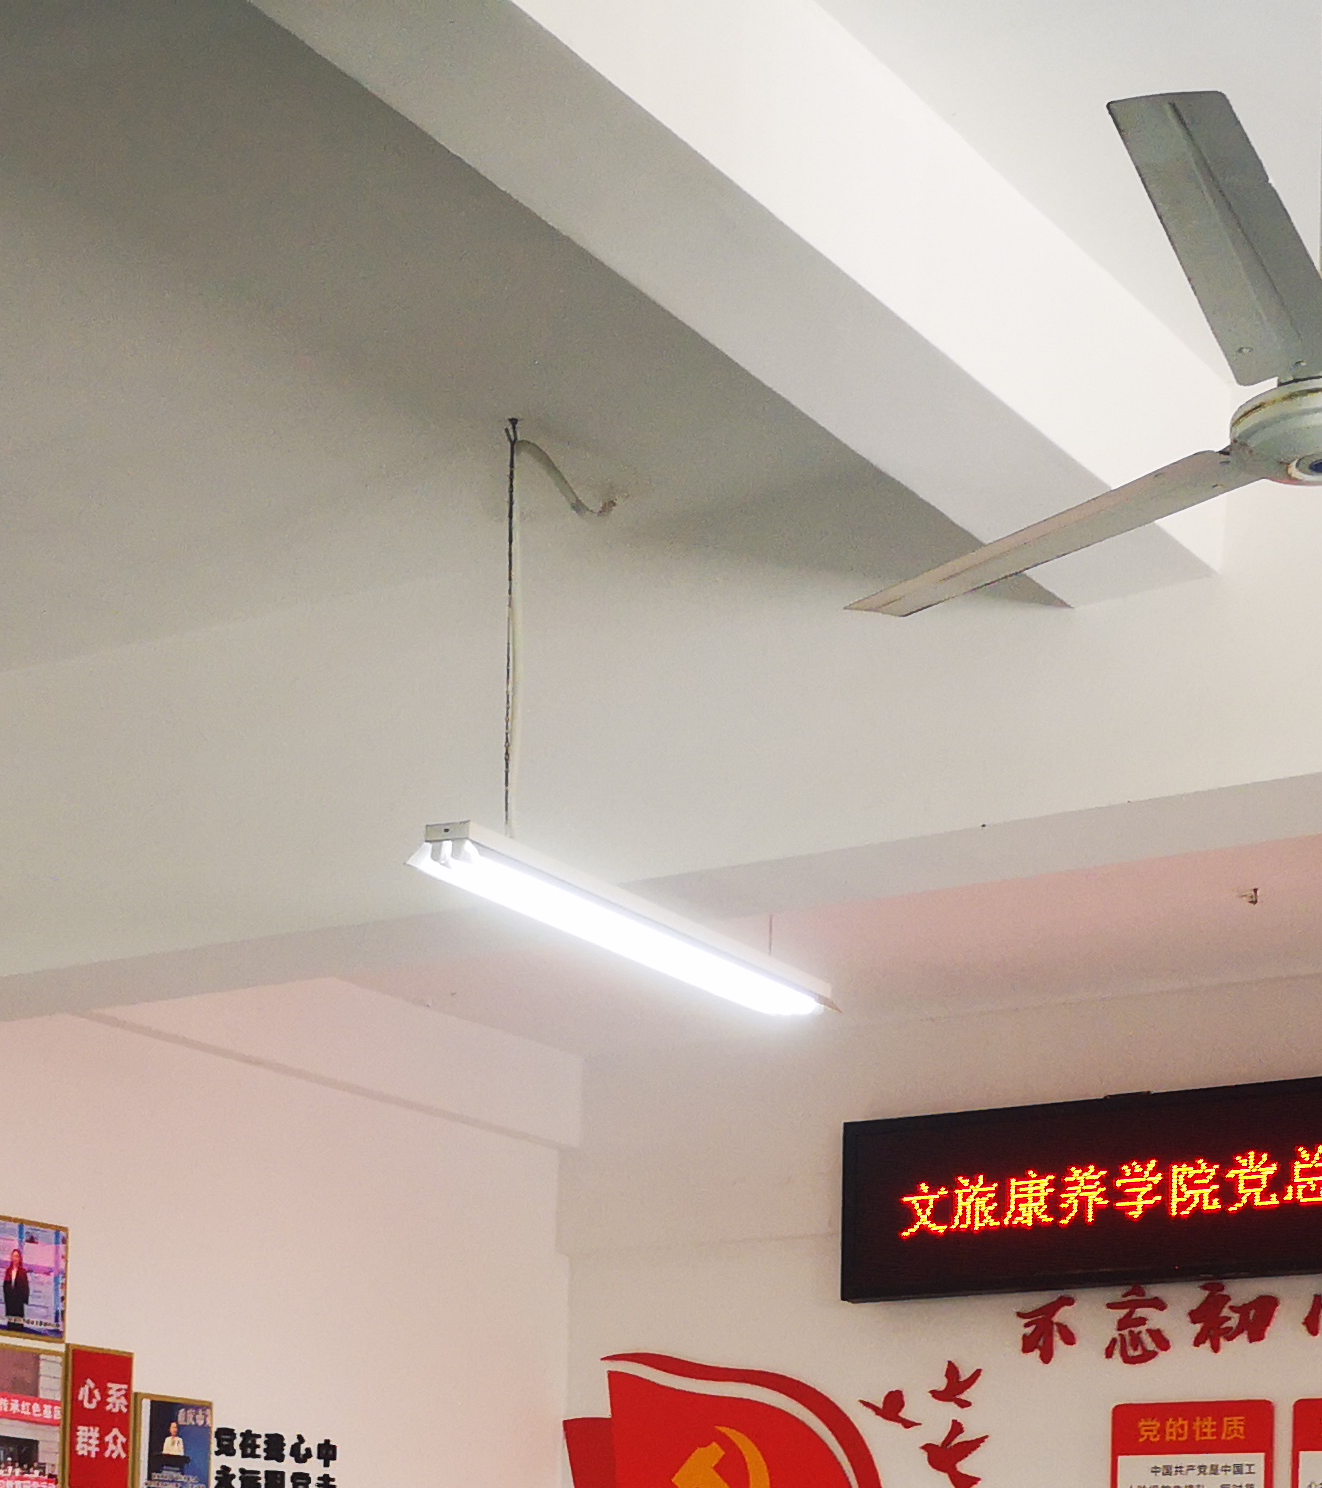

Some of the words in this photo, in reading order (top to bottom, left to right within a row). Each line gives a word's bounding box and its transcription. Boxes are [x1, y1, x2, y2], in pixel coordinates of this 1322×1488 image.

[78, 1378, 129, 1414] 心系
[76, 1425, 128, 1460] 群众
[1138, 1416, 1246, 1442] 党的性质
[1150, 1463, 1256, 1476] 中国共产党是中国工
